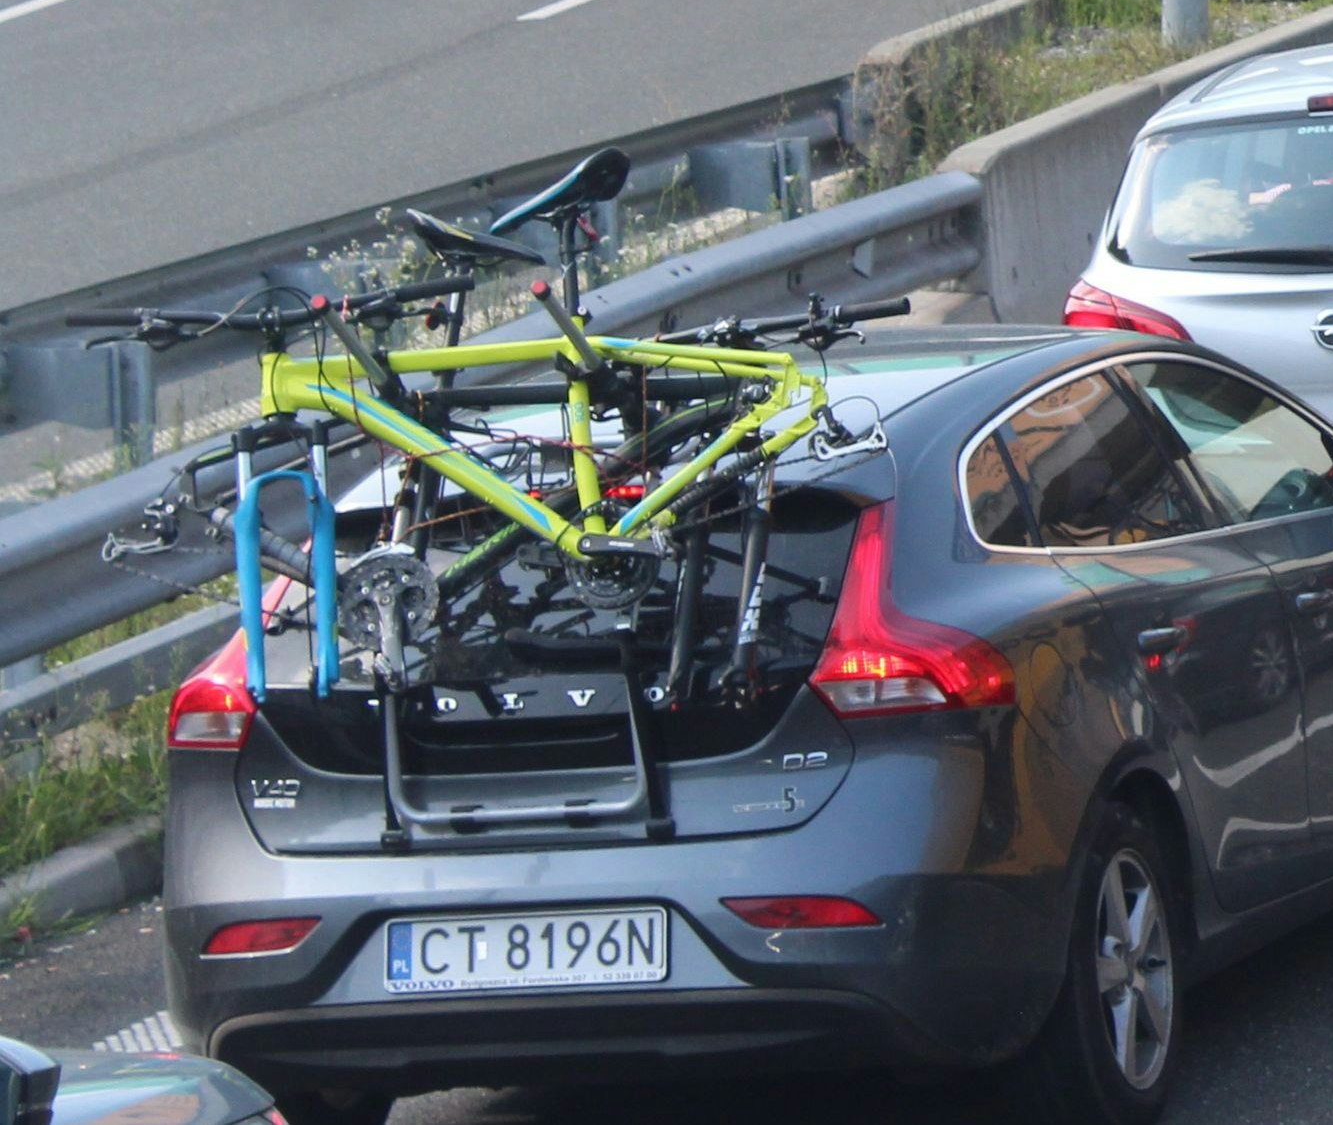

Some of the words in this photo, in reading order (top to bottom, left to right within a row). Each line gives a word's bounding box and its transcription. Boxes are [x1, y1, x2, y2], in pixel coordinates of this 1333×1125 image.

[1297, 124, 1327, 135] OPEL
[783, 751, 828, 771] D2
[250, 778, 301, 797] V40
[392, 959, 409, 974] PL
[420, 925, 486, 975] CT
[506, 917, 655, 971] 8196N
[391, 979, 454, 990] VOLVO
